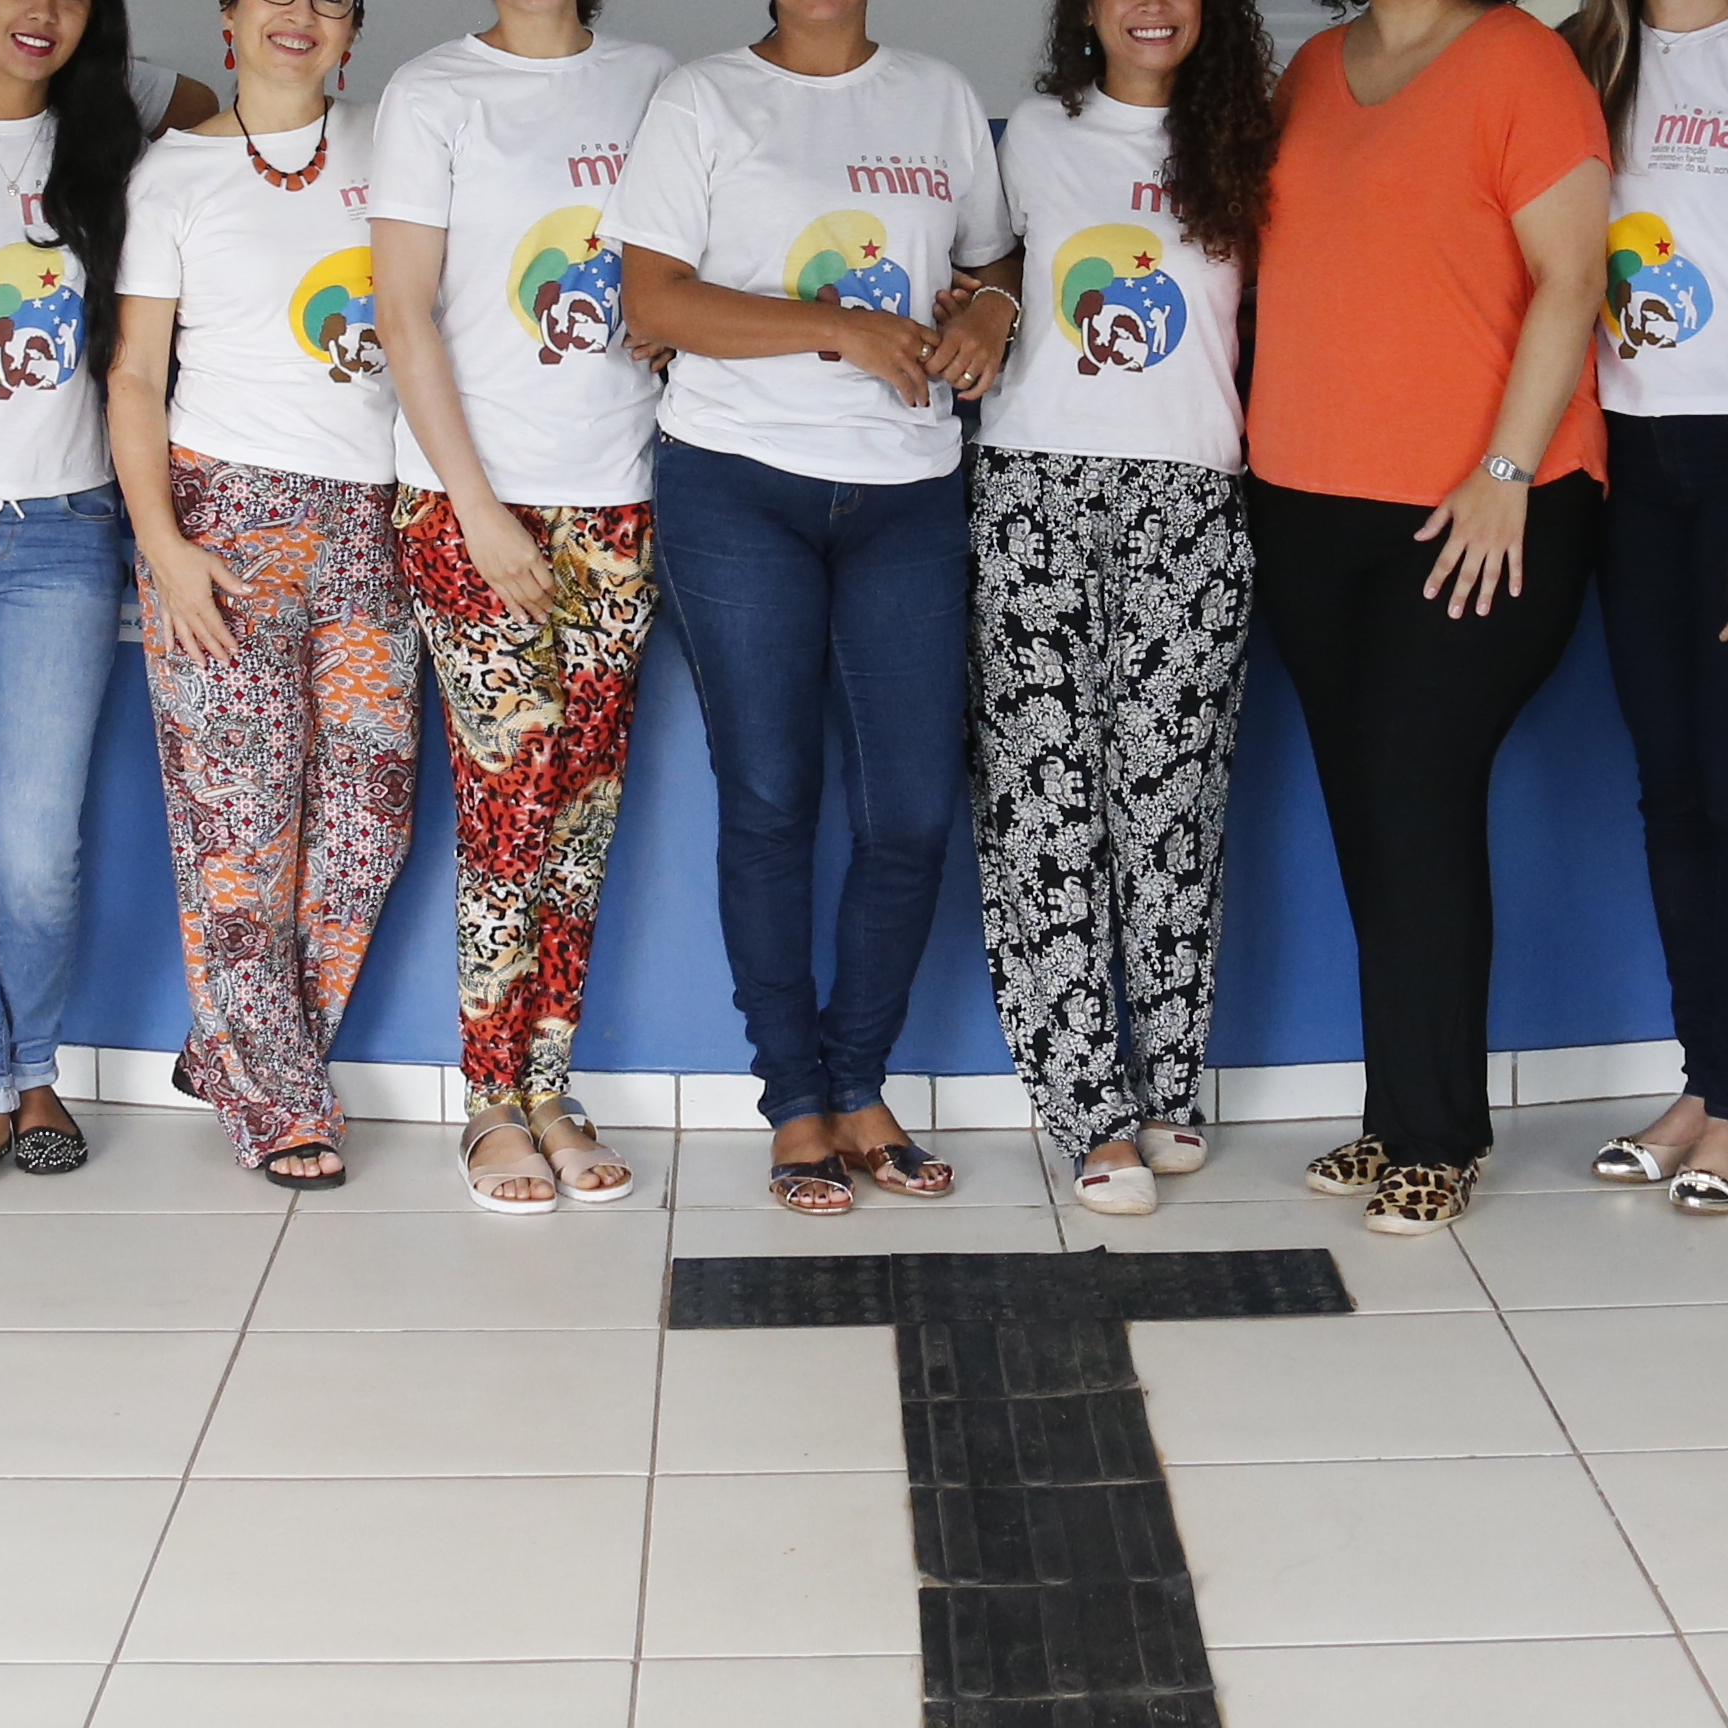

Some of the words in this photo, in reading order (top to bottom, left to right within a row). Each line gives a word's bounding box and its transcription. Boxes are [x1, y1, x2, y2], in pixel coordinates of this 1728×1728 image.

[568, 142, 628, 187] mi
[847, 156, 952, 203] mina
[860, 154, 948, 168] PROJETO
